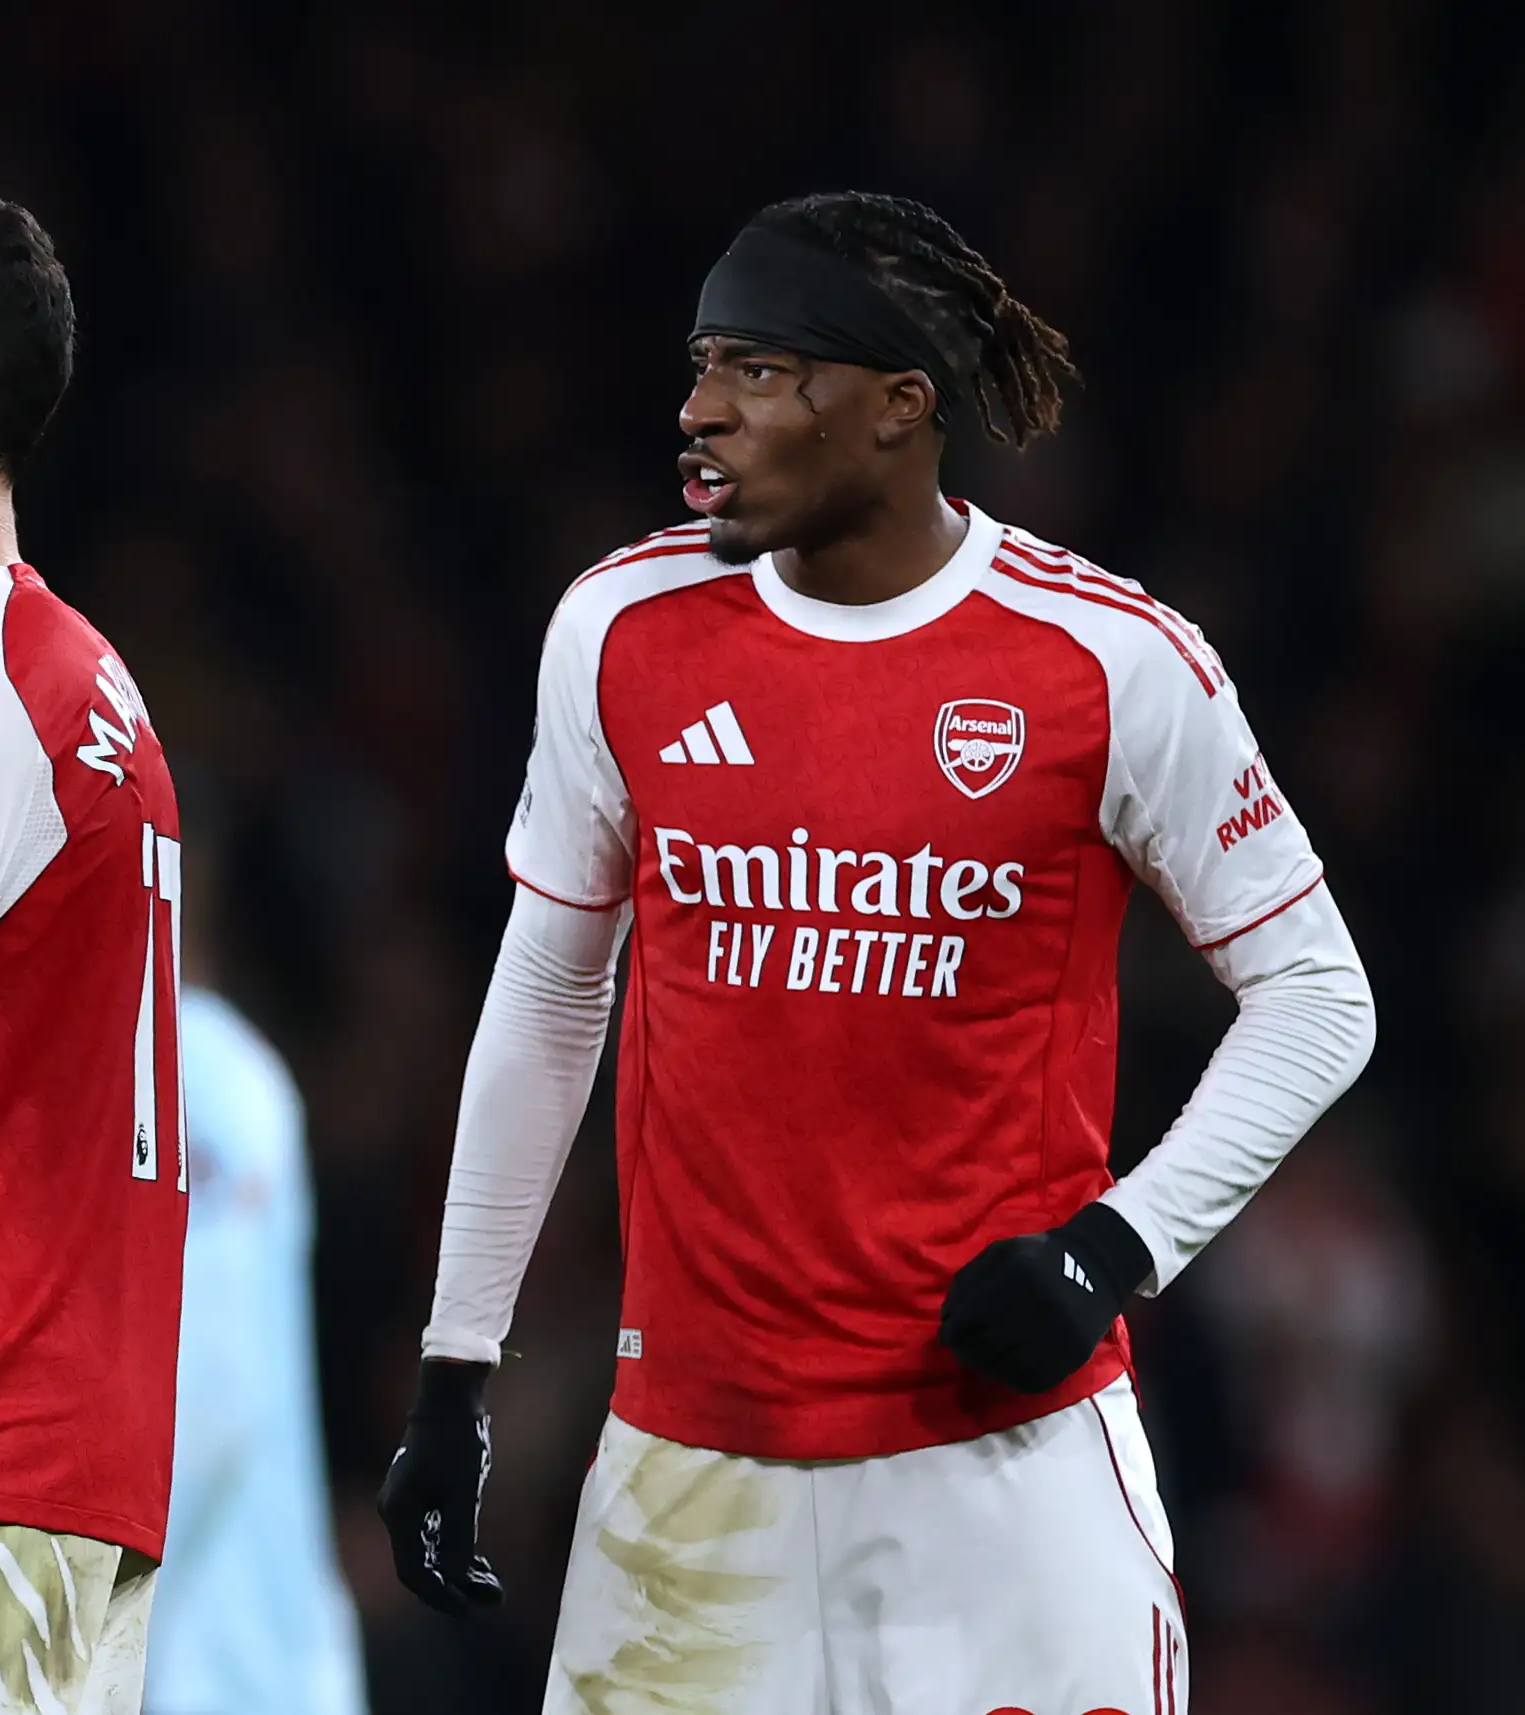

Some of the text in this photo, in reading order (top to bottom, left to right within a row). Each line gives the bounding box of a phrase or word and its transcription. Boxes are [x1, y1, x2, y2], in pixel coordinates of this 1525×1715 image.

[949, 714, 1012, 736] Arsenal
[653, 827, 1025, 920] Emirates
[707, 921, 966, 998] FLY BETTER
